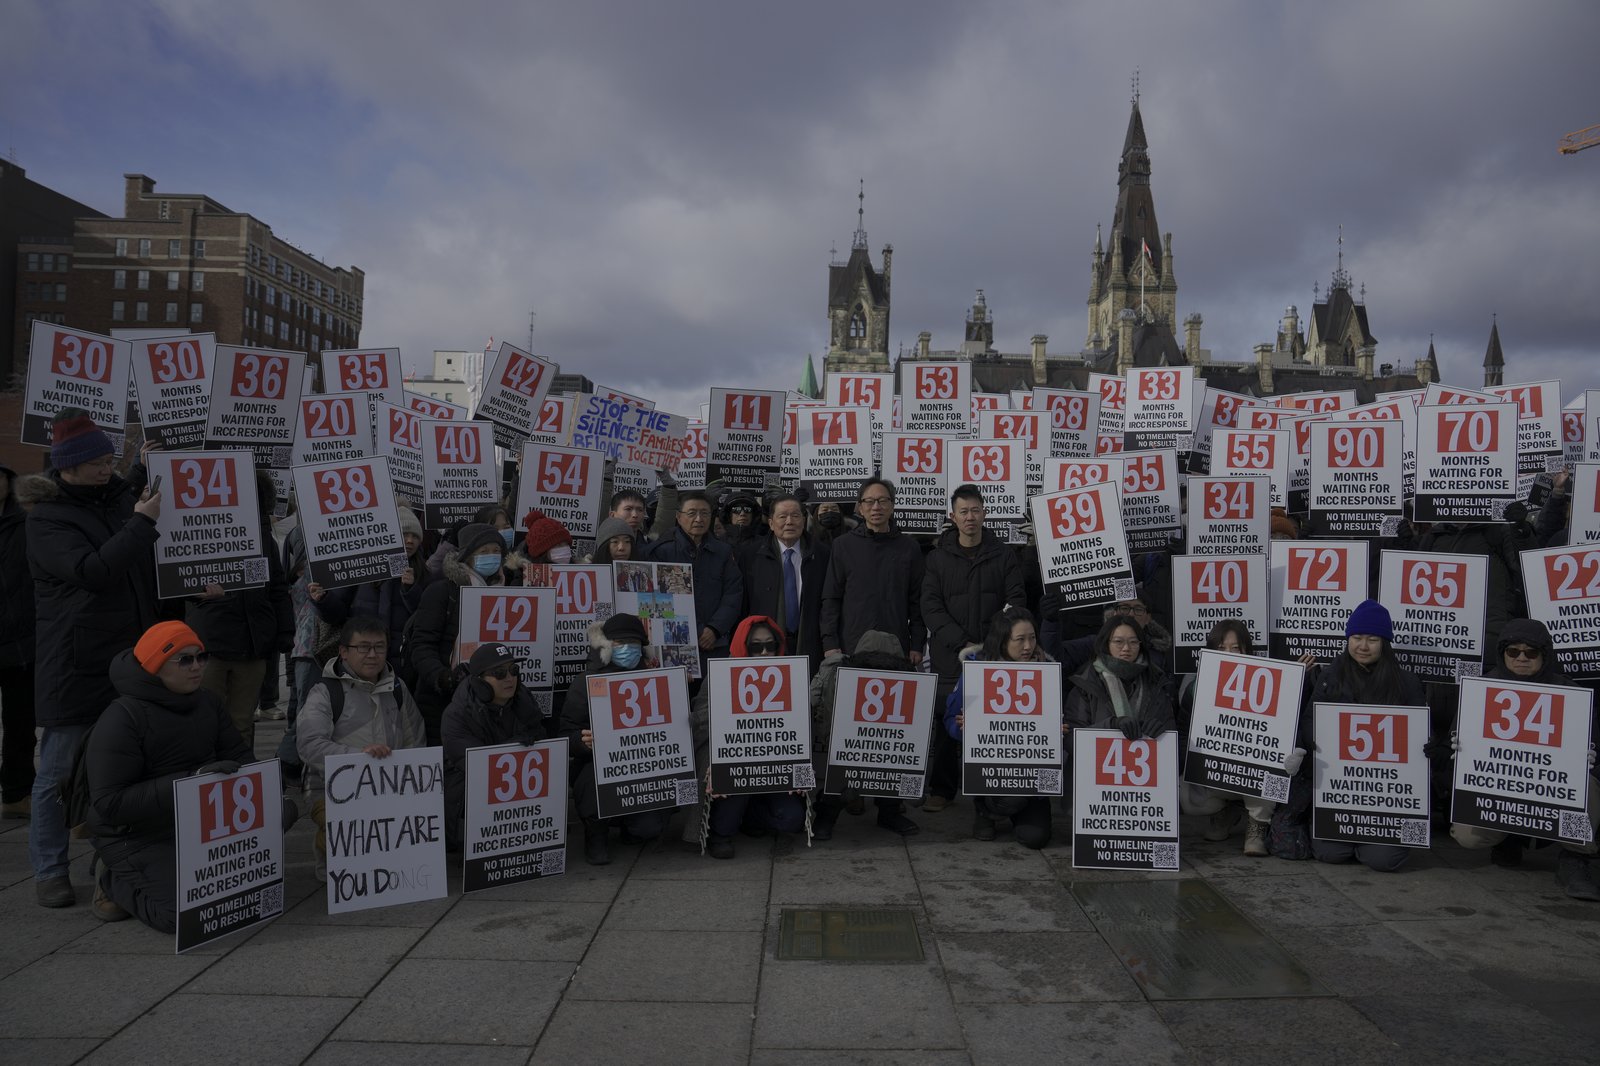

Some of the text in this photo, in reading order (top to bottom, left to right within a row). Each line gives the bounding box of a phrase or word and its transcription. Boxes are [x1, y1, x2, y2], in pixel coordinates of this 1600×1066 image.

[58, 336, 107, 380] 30
[155, 342, 198, 382] 30
[345, 355, 383, 389] 35
[238, 355, 283, 397] 36
[507, 358, 540, 393] 42
[920, 368, 953, 398] 53
[1143, 372, 1176, 399] 33
[844, 380, 875, 408] 15
[919, 403, 952, 411] MONTHS
[1142, 403, 1174, 411] MONTHS
[309, 400, 350, 437] 20
[587, 396, 629, 421] STOP
[636, 409, 670, 432] THE
[731, 396, 762, 430] 11
[906, 422, 923, 430] IRCC
[1052, 396, 1084, 428] 68
[1146, 420, 1187, 428] RESPONSE
[818, 414, 852, 444] 71
[1446, 412, 1491, 451] 70
[441, 428, 476, 462] 40
[902, 440, 937, 472] 53
[1232, 436, 1269, 468] 55
[1334, 429, 1378, 466] 90
[543, 454, 582, 494] 54
[968, 447, 1004, 480] 63
[1123, 457, 1160, 492] 55
[1429, 468, 1502, 477] WAITING FOR
[1441, 455, 1489, 465] MONTHS
[179, 460, 232, 507] 34
[321, 468, 371, 512] 38
[1322, 484, 1389, 493] WAITING FOR
[1334, 472, 1378, 481] MONTHS
[1422, 480, 1509, 489] IRCC RESPONSE
[1209, 483, 1249, 518] 34
[1316, 495, 1396, 505] IRCC RESPONSE
[183, 512, 233, 526] MONTHS
[327, 512, 374, 528] MONTHS
[1055, 494, 1097, 536] 39
[170, 526, 247, 542] WAITING FOR
[314, 534, 397, 556] IRCC RESPONSE
[318, 523, 388, 542] WAITING FOR
[1060, 536, 1102, 552] MONTHS
[164, 539, 254, 557] IRCC RESPONSE
[328, 554, 388, 571] NO TIMELINES
[1051, 547, 1115, 565] WAITING FOR
[178, 561, 244, 575] NO TIMELINES
[184, 573, 241, 587] NO RESULTS
[334, 564, 387, 580] NO RESULTS
[1048, 557, 1124, 578] IRCC RESPONSE
[1197, 562, 1242, 602] 40
[1296, 549, 1340, 590] 72
[1553, 552, 1600, 599] 22
[556, 572, 593, 613] 40
[1060, 577, 1116, 592] NO TIMELINES
[1065, 587, 1114, 601] NO RESULTS
[1409, 562, 1459, 606] 65
[481, 597, 532, 640] 42
[618, 678, 666, 726] 31
[738, 667, 784, 712] 62
[861, 680, 905, 722] 81
[990, 670, 1036, 714] 35
[1222, 665, 1274, 713] 40
[736, 717, 784, 729] MONTHS
[1492, 690, 1554, 744] 34
[718, 744, 803, 758] IRCC RESPONSE
[724, 731, 796, 744] WAITING FOR
[1348, 714, 1400, 762] 51
[730, 764, 792, 776] NO TIMELINES
[1102, 739, 1149, 785] 43
[1489, 747, 1551, 765] MONTHS
[327, 762, 444, 804] CANADA
[495, 751, 543, 801] 36
[734, 776, 788, 787] NO RESULTS
[1344, 766, 1398, 779] MONTHS
[1473, 759, 1568, 784] WAITING FOR
[1322, 792, 1420, 809] IRCC RESPONSE
[1330, 779, 1412, 794] WAITING FOR
[1463, 773, 1576, 801] IRCC RESPONSE
[208, 777, 256, 839] 18
[1335, 813, 1349, 822] NO
[1476, 797, 1558, 819] NO TIMELINES
[1480, 810, 1552, 830] NO RESULTS
[327, 816, 439, 857] WHAT ARE
[1339, 825, 1401, 838] NO RESULTS
[208, 836, 258, 862] MONTHS
[194, 848, 270, 882] WAITING FOR
[187, 862, 276, 903] IRCC RESPONSE
[329, 869, 368, 903] YOU
[200, 892, 260, 921] NO TIMELINE
[204, 904, 261, 933] NO RESULTS
